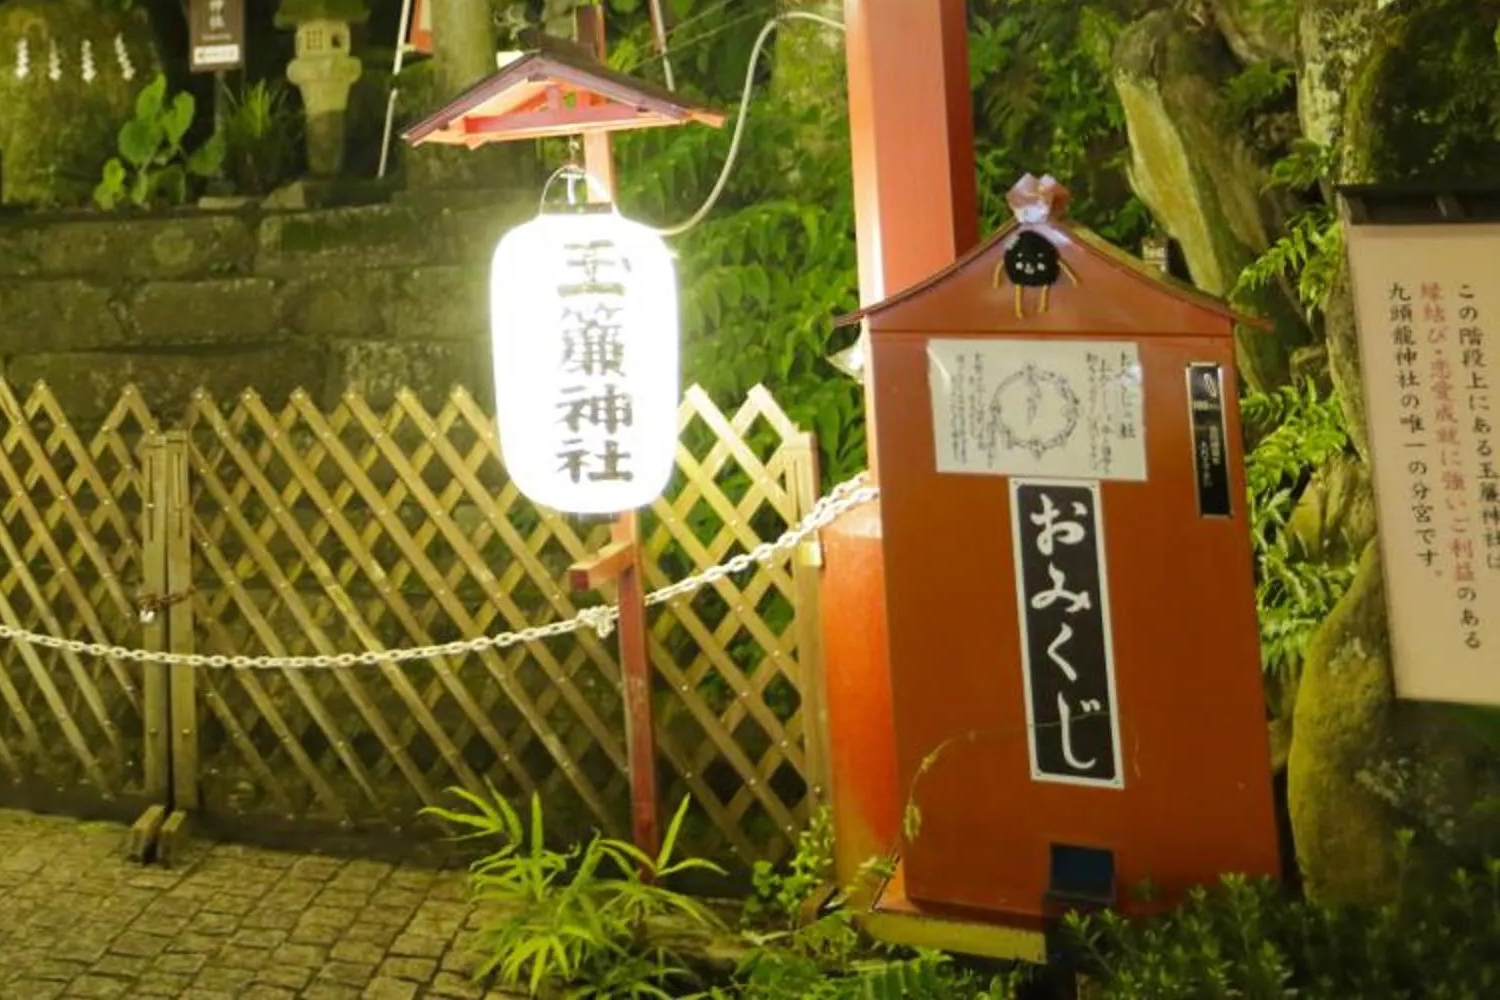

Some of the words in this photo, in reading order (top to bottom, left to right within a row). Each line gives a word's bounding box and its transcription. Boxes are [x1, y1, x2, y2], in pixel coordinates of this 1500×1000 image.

[555, 239, 633, 485] 玉簾神社
[1030, 493, 1101, 770] おみくじ
